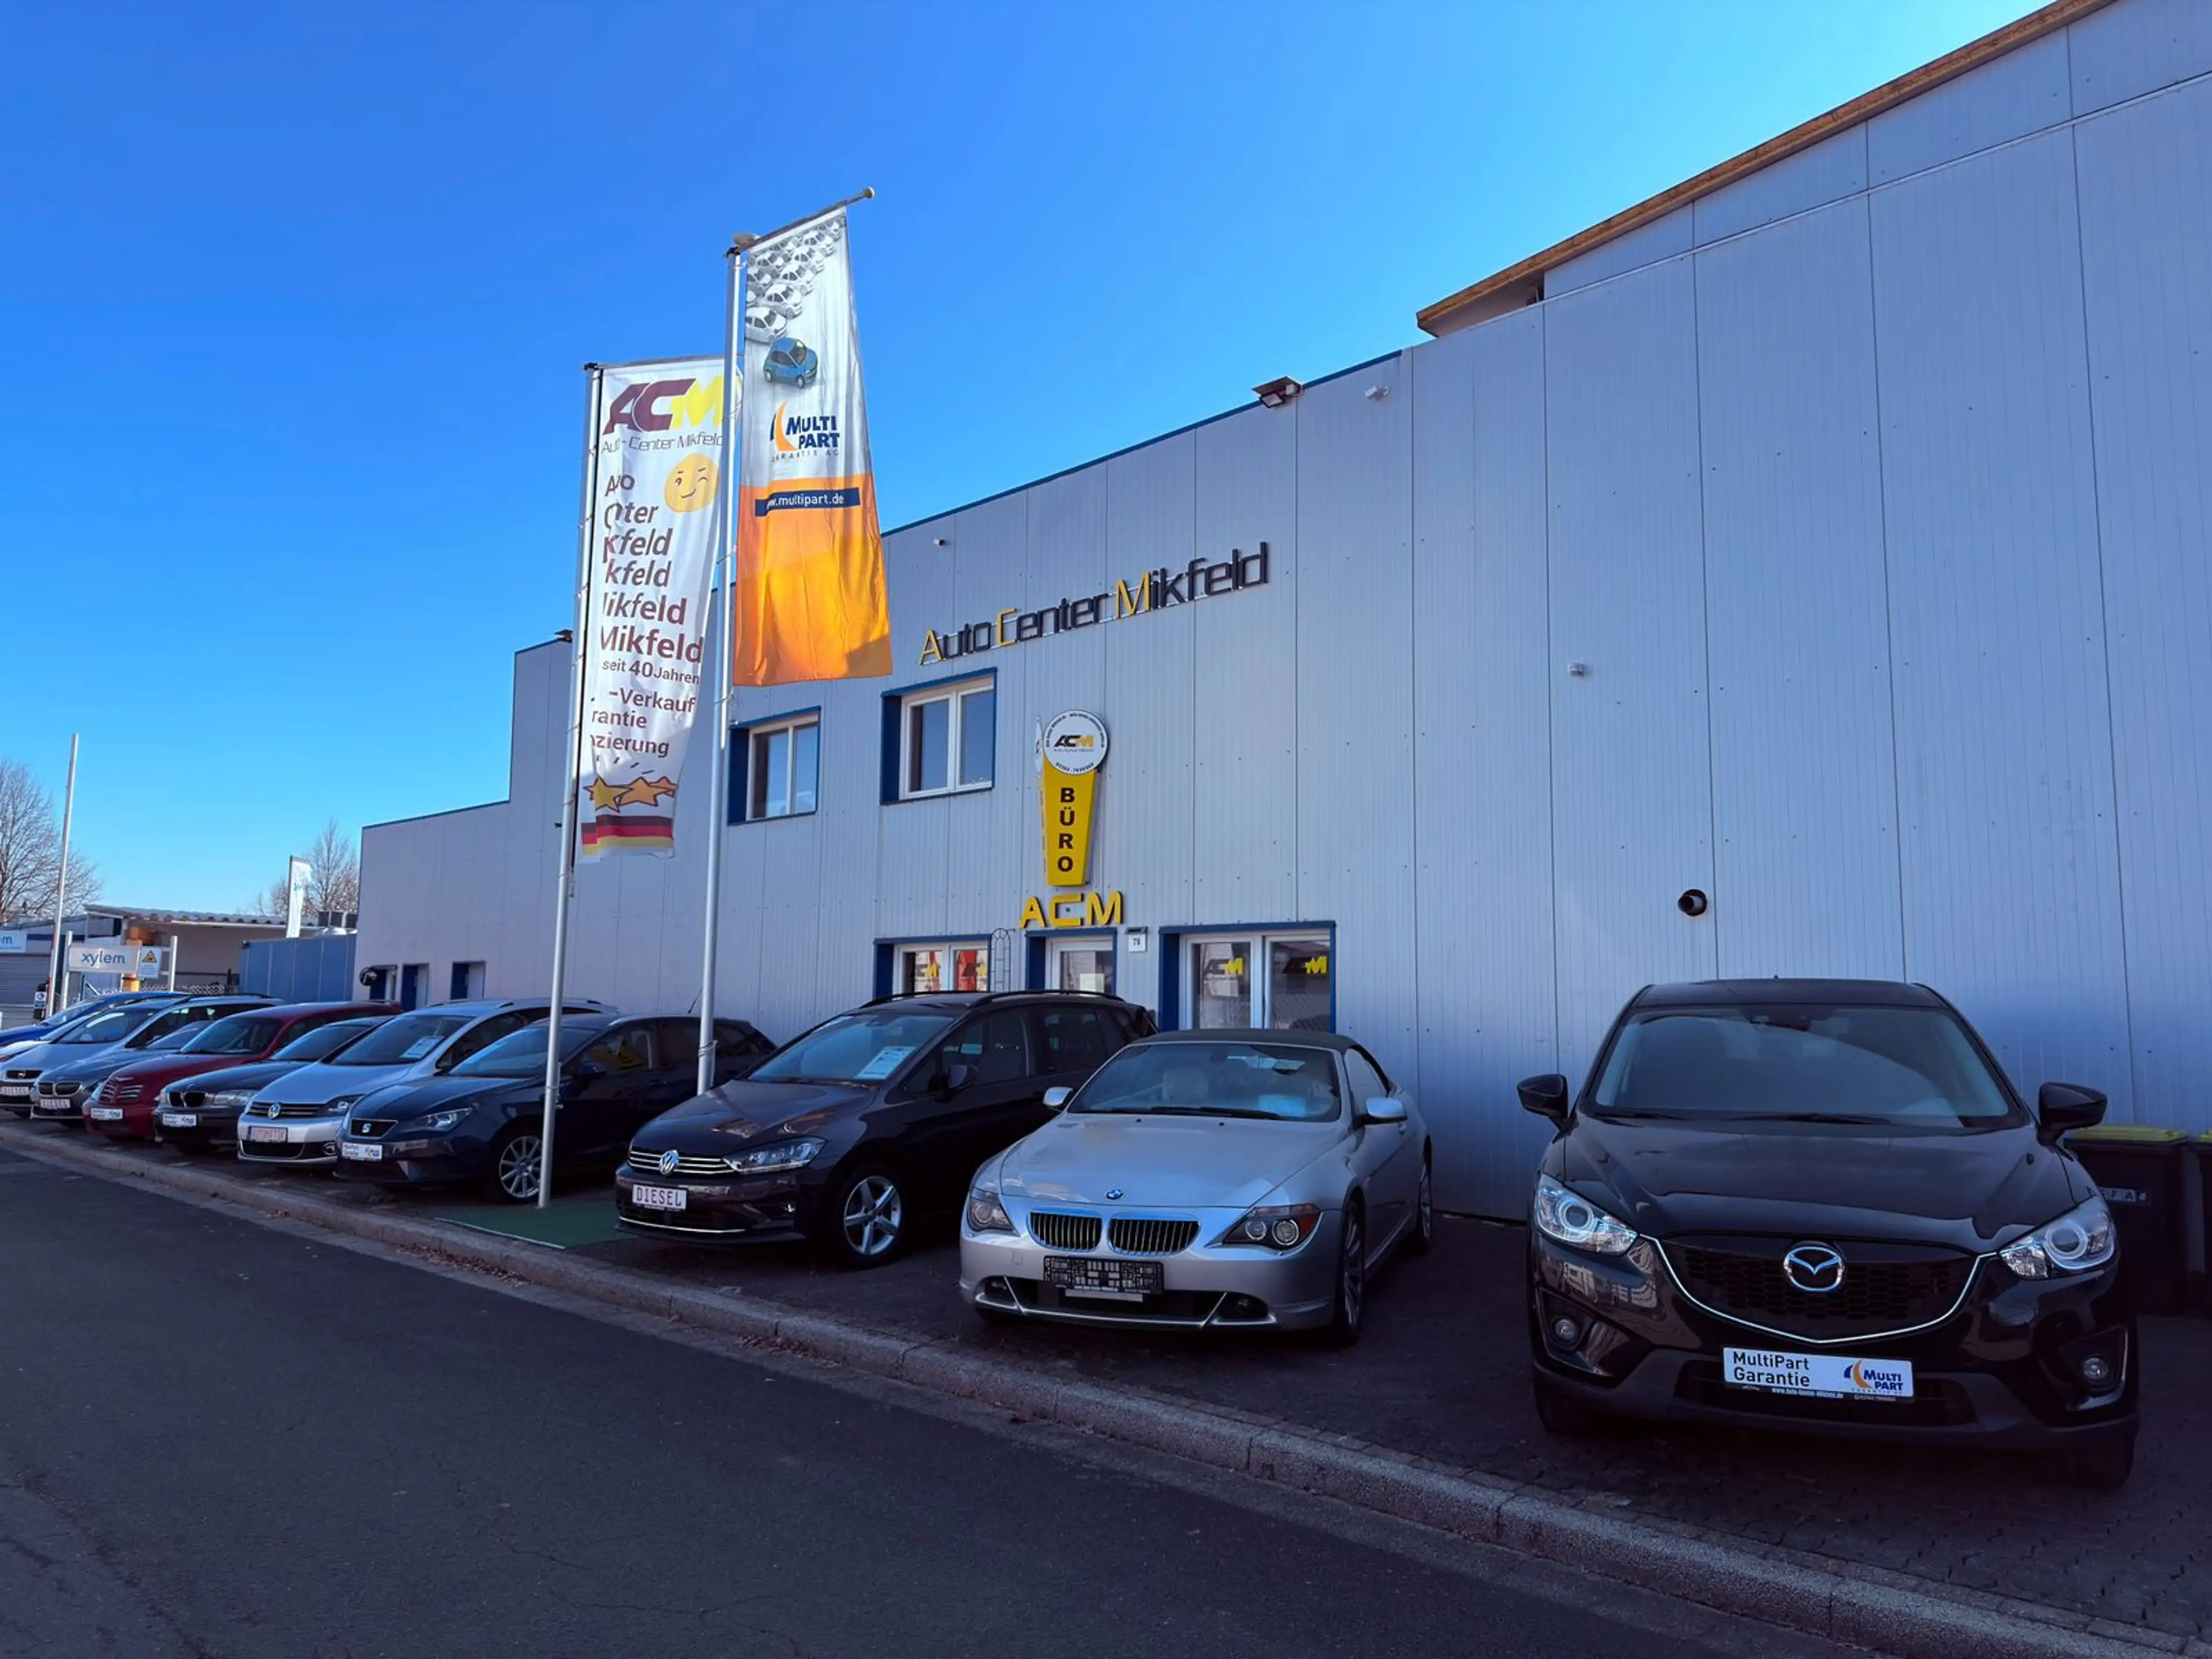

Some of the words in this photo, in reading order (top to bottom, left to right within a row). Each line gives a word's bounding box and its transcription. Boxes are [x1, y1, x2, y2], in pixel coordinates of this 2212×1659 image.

[603, 373, 724, 435] ACM
[786, 415, 836, 435] MULTI
[629, 435, 675, 452] Center
[798, 433, 840, 450] PART
[920, 620, 991, 665] Auto
[995, 592, 1109, 647] Center
[1115, 541, 1269, 619] Mikfeld
[602, 658, 626, 672] seit
[629, 660, 653, 677] 40
[654, 667, 699, 685] Jahren
[1054, 734, 1094, 748] ACM
[1057, 787, 1075, 872] BÜRO
[1019, 890, 1124, 930] ACM
[81, 950, 127, 967] xylem
[637, 1188, 681, 1207] DIESEL
[1733, 1351, 1810, 1370] MultiPart
[1733, 1367, 1810, 1387] Garantie
[1863, 1369, 1902, 1382] MULTI
[1874, 1381, 1903, 1391] PART
